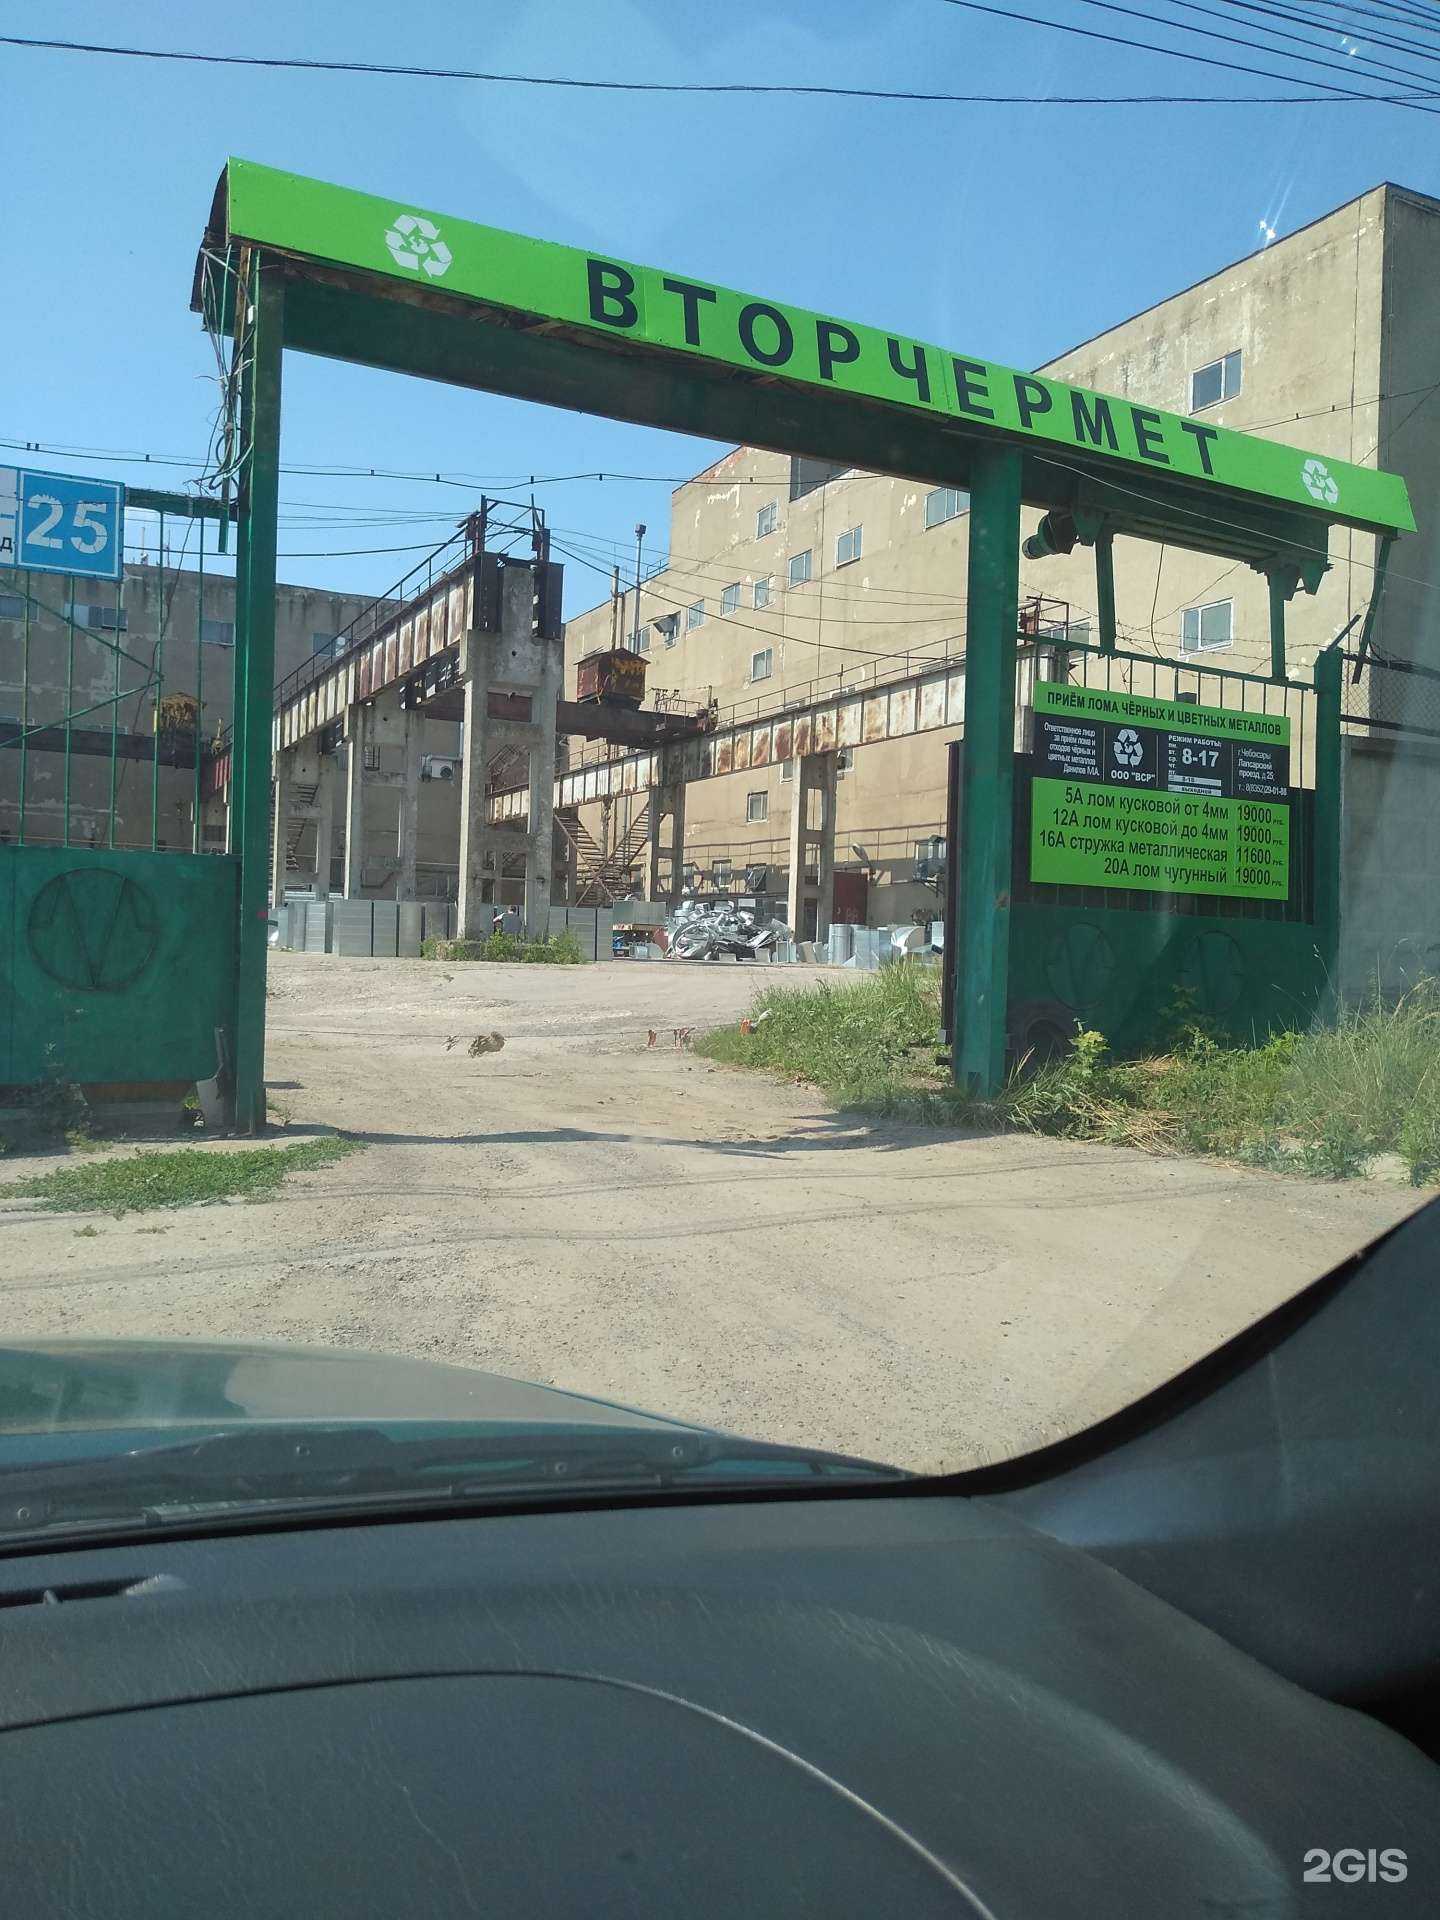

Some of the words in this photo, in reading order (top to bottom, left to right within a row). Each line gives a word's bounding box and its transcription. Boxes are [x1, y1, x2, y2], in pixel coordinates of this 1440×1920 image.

[587, 258, 1218, 475] ВТОРЧЕРМЕТ
[26, 494, 108, 554] 25
[1044, 722, 1081, 735] Ответственное
[1047, 691, 1085, 708] ПРИЁМ
[1087, 697, 1119, 713] ЛОМА
[1121, 701, 1165, 720] ЧЁРНЫХ
[1168, 709, 1175, 722] И
[1177, 710, 1226, 728] ЦВЕТНЫХ
[1229, 718, 1281, 735] МЕТАЛЛОВ
[1168, 734, 1192, 744] РЕЖИМ
[1111, 769, 1129, 780] ООО
[1131, 771, 1155, 782] "ВСР"
[1182, 748, 1219, 767] 8-17
[1065, 786, 1083, 805] 5А
[1087, 793, 1115, 808] лом
[1119, 797, 1180, 815] кусковой
[1184, 803, 1199, 816] от
[1202, 802, 1229, 820] 4мм
[1237, 804, 1272, 823] 19000
[1053, 808, 1079, 827] 12А
[1083, 815, 1111, 830] лом
[1116, 819, 1177, 836] кусковой
[1180, 825, 1198, 840] до
[1201, 823, 1228, 841] 4мм
[1237, 825, 1272, 844] 19000
[1040, 829, 1066, 848] 16А
[1070, 836, 1125, 855] стружка
[1129, 842, 1228, 862] металлическая
[1236, 846, 1271, 865] 11600
[1104, 857, 1130, 876] 20А
[1133, 864, 1160, 878] лом
[1165, 866, 1227, 884] чугунный
[1236, 866, 1271, 885] 19000
